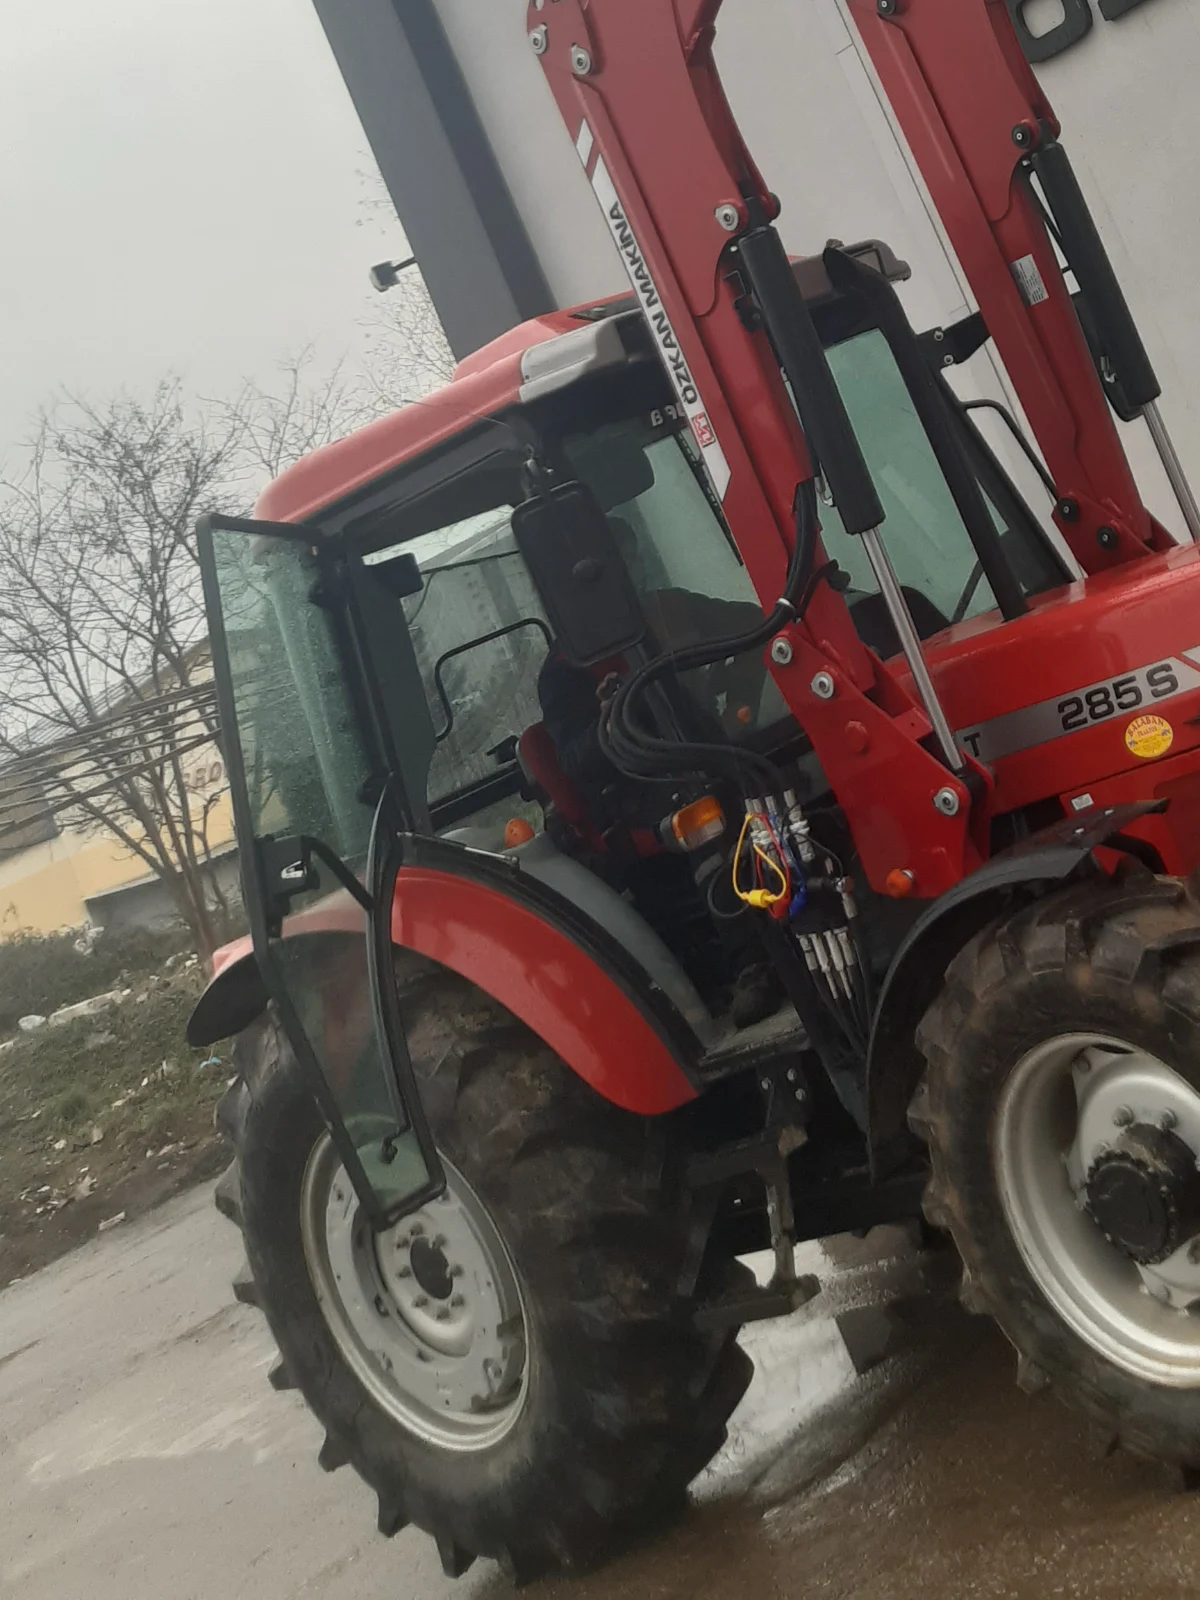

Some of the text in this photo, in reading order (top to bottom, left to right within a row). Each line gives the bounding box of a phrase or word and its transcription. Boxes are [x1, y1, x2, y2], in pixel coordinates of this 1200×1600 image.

[609, 201, 698, 405] ÖZKAN MAKİNA
[1057, 675, 1143, 732] 285
[1145, 662, 1179, 699] S
[1127, 716, 1164, 737] BALABAN
